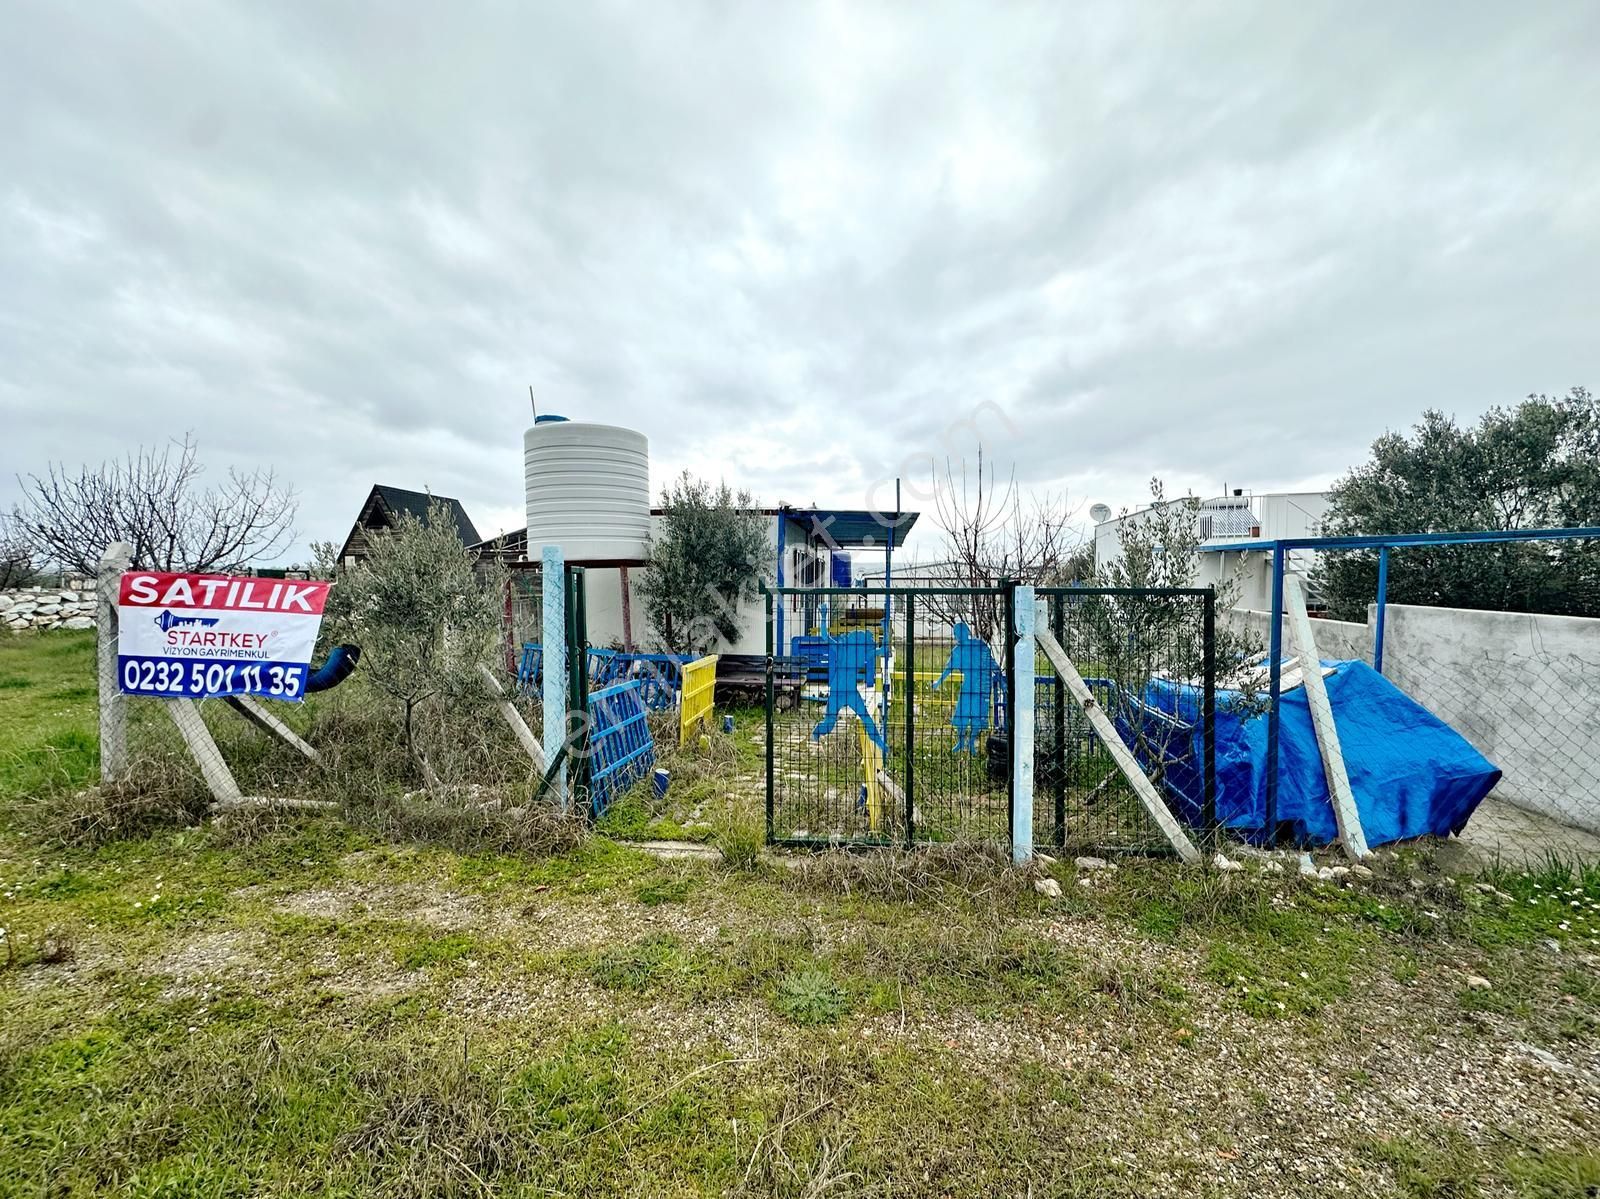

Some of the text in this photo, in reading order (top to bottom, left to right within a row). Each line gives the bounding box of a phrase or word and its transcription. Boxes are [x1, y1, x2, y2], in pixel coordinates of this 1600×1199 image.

[128, 576, 319, 612] SATILIK
[163, 646, 270, 659] VİZYON GAYRİMENKUL
[167, 630, 268, 648] STARTKEY
[124, 660, 302, 697] 0232 501 11 35
